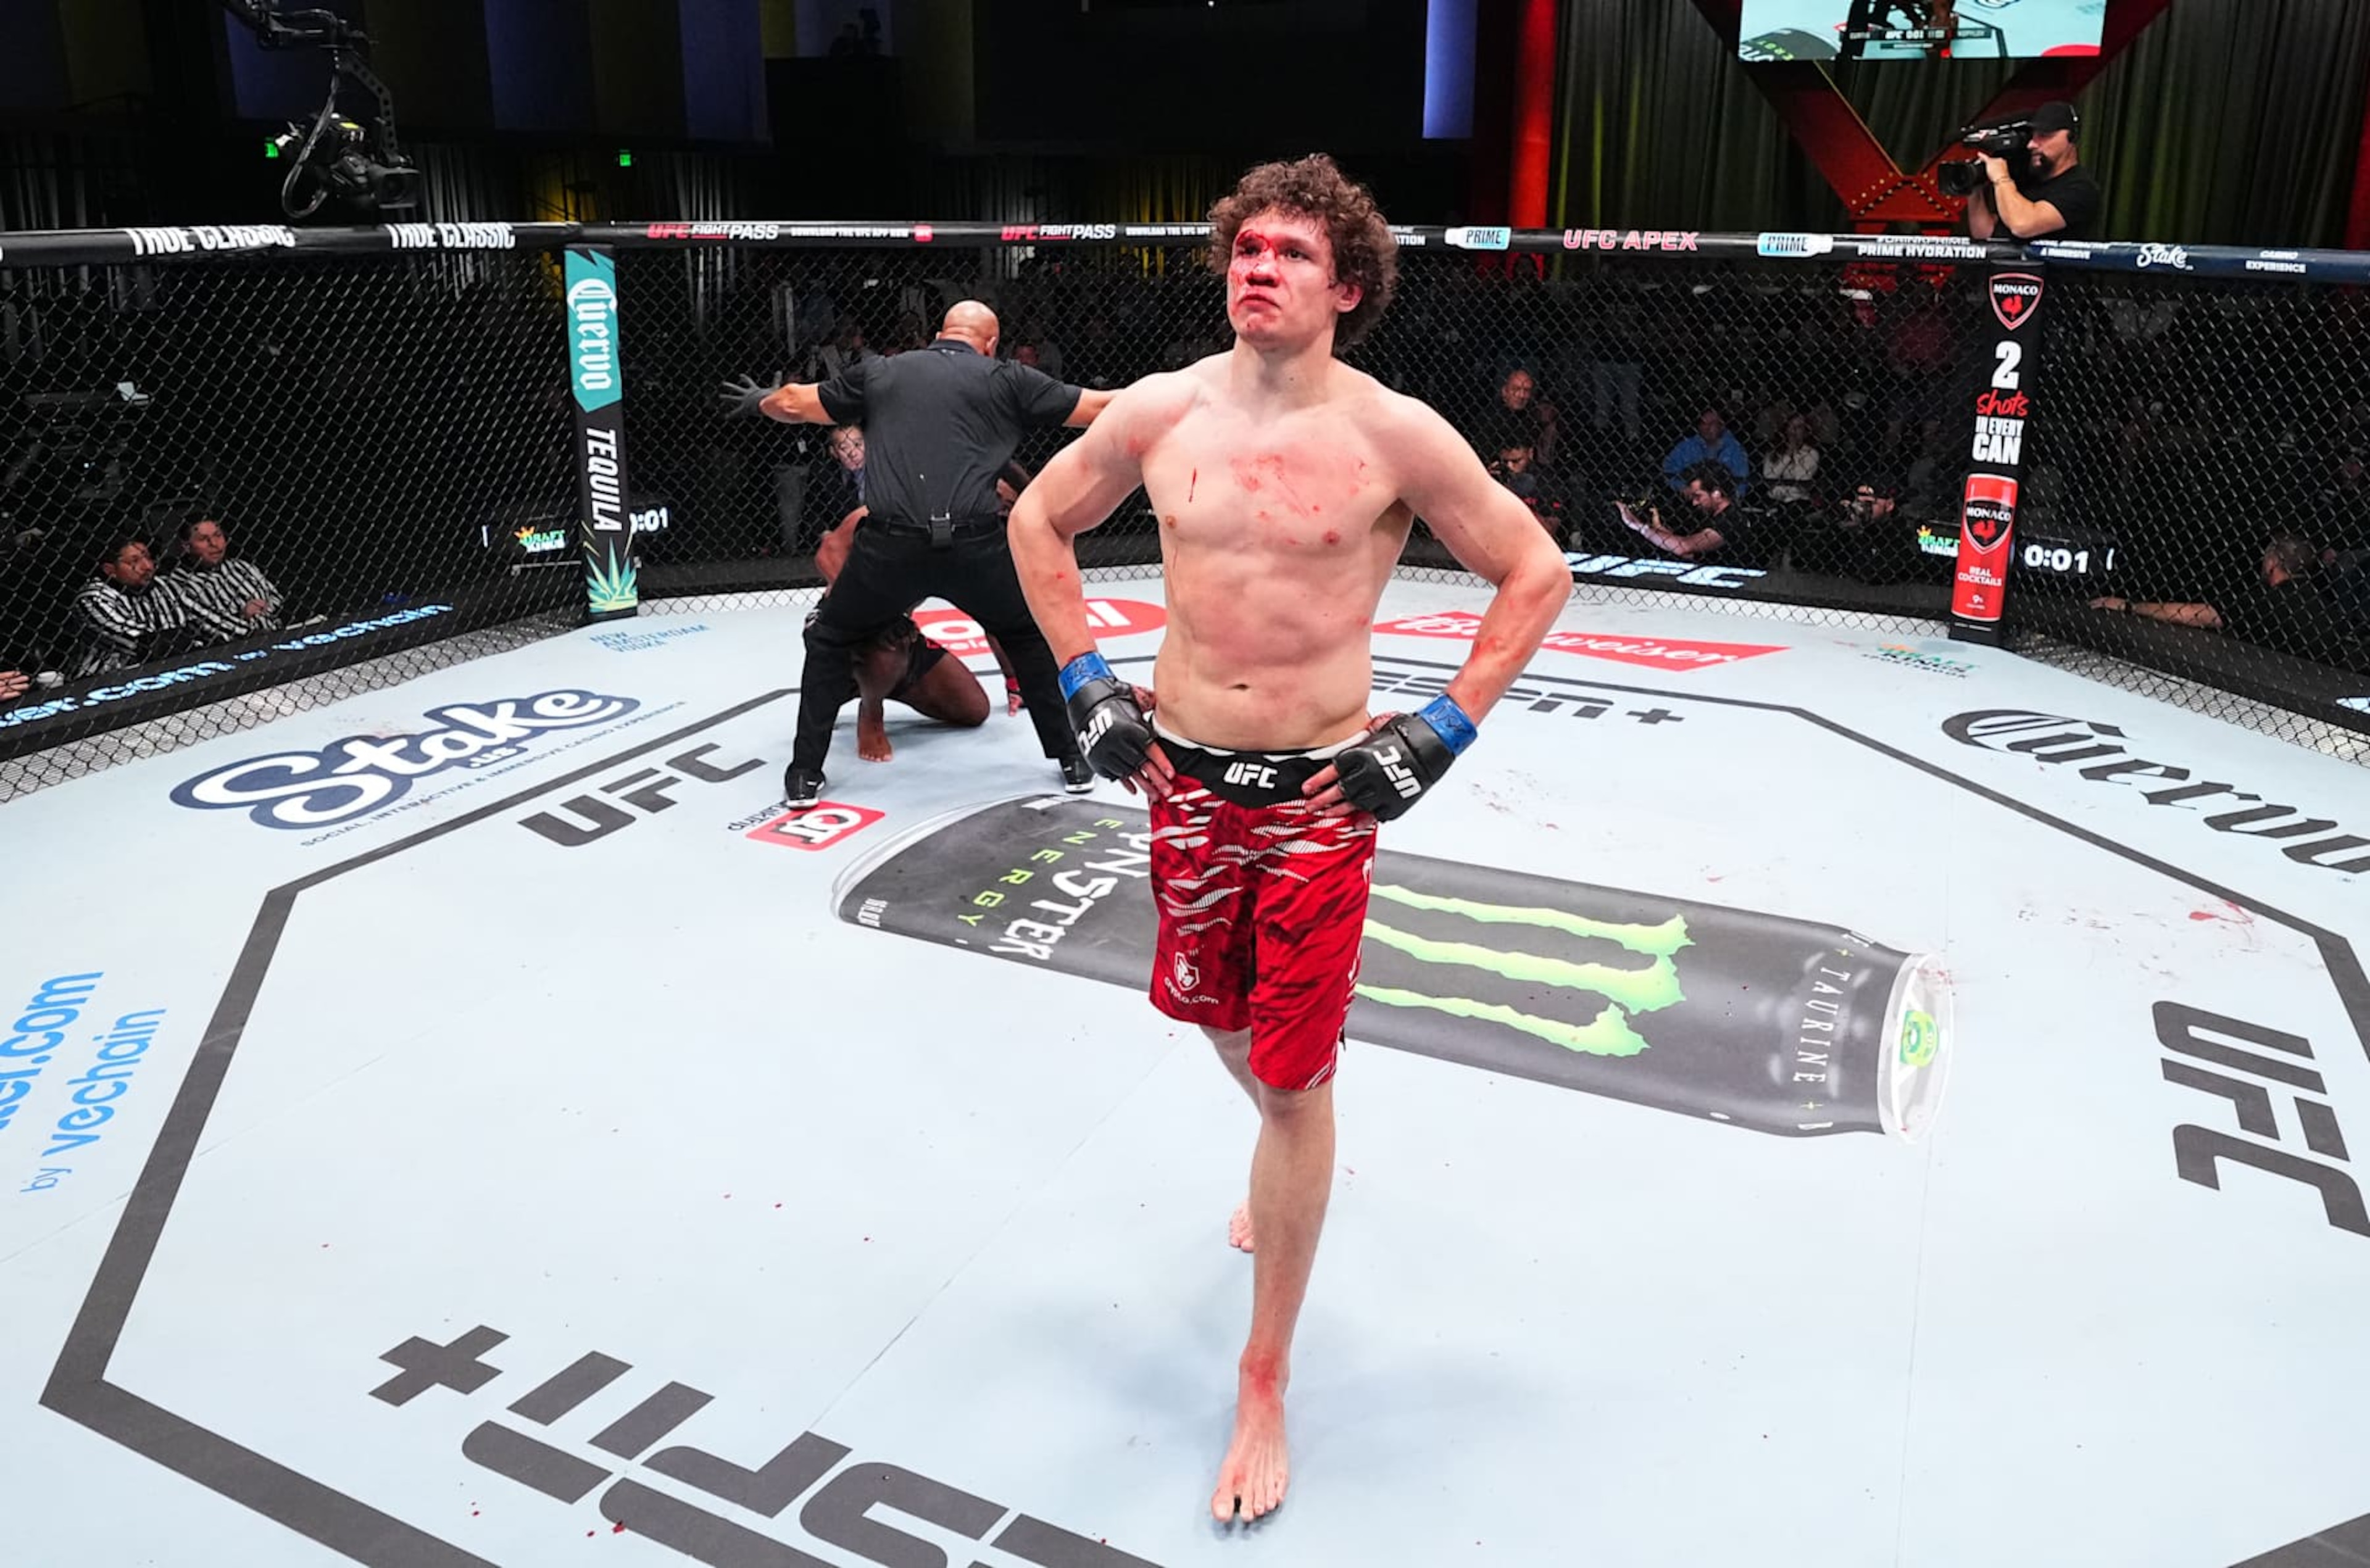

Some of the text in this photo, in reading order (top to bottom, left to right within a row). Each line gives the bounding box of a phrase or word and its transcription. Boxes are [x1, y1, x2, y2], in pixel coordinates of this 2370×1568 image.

[435, 222, 516, 249] CLASSIC
[647, 224, 780, 239] UFC FIGHT PASS
[1001, 224, 1116, 240] UFC FIGHT PASS
[1466, 230, 1502, 244] PRIME
[1563, 229, 1699, 251] UFC APEX
[1767, 236, 1808, 252] PRIME
[1857, 244, 1987, 259] PRIME HYDRATION
[2136, 243, 2188, 268] Stake
[1993, 283, 2039, 296] MONACO
[567, 278, 618, 390] Cuervo
[1991, 341, 2022, 389] 2
[1988, 417, 2024, 437] EVERY
[1971, 432, 2022, 465] CAN
[586, 428, 623, 531] TEQUILA
[1966, 506, 2012, 522] MONACO
[1969, 565, 1992, 578] REAL
[2024, 544, 2089, 574] 0:01
[1957, 571, 2002, 587] COCKTAILS
[1078, 707, 1113, 757] UFC
[185, 688, 627, 826] Stake
[1223, 762, 1278, 789] UFC
[1373, 745, 1423, 800] UFC
[517, 742, 767, 848] UFC
[1942, 709, 2370, 873] Cuervo
[957, 818, 1123, 927] ENERGY
[1792, 966, 1851, 1082] TAURINE
[20, 1008, 167, 1193] by vechain
[2152, 1000, 2370, 1238] UFC
